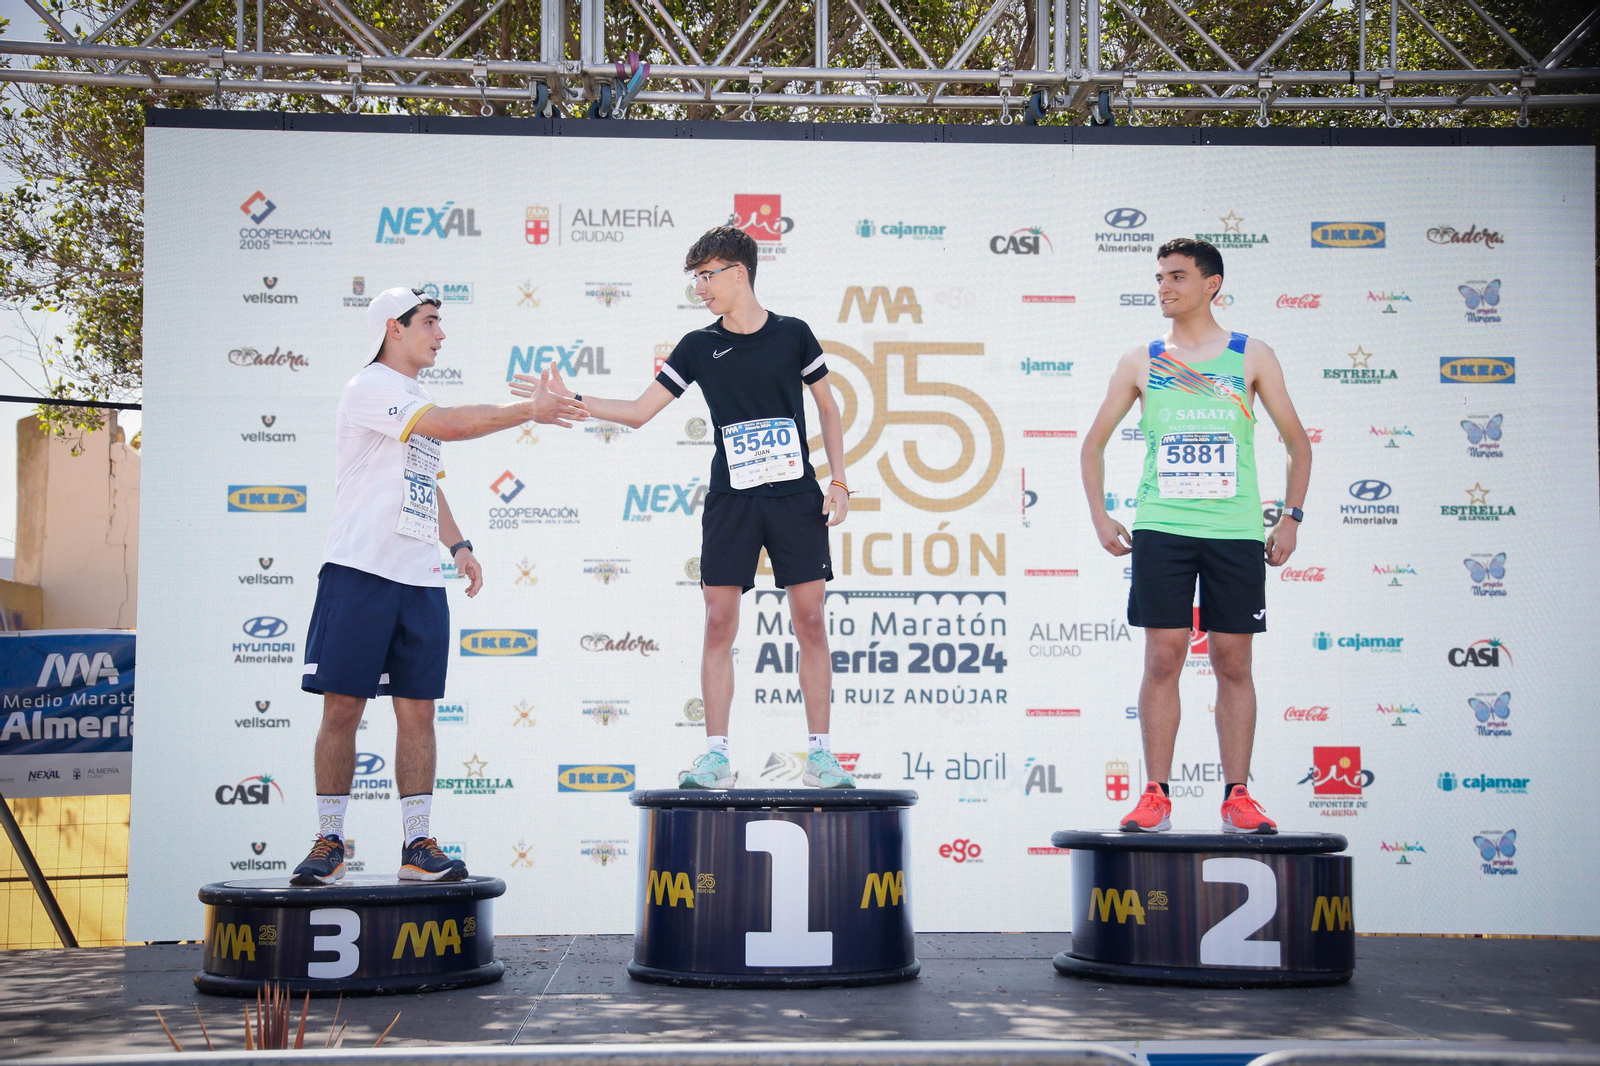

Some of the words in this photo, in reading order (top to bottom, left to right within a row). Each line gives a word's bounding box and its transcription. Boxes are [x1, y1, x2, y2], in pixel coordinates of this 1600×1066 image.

[376, 202, 482, 243] NEXAL
[571, 205, 674, 228] ALMERÍA
[240, 227, 331, 240] COOPERACIÓN
[571, 230, 624, 242] CIUDAD
[881, 221, 946, 239] cajamar
[1321, 229, 1377, 241] IKEA
[1095, 233, 1154, 242] HYUNDAI
[1195, 233, 1269, 243] ESTRELLA
[240, 240, 270, 250] 2005
[989, 235, 1040, 255] CASI
[1097, 244, 1153, 253] Almerialva
[443, 284, 469, 293] SAFA
[243, 292, 298, 304] vellsam
[1120, 294, 1156, 306] SER
[506, 340, 611, 382] NEXAL
[1021, 357, 1074, 377] jamar
[418, 367, 462, 379] RACIÓN
[1323, 369, 1398, 379] ESTRELLA
[1450, 364, 1506, 377] IKEA
[1176, 408, 1236, 420] SAKATA
[1169, 424, 1200, 432] PASSION
[1209, 423, 1226, 431] Seed
[241, 431, 296, 442] vellsam
[1121, 429, 1144, 440] SE
[733, 428, 791, 455] 5540
[754, 449, 770, 457] JUAN
[1166, 444, 1225, 464] 5881
[239, 493, 298, 505] IKEA
[623, 478, 709, 521] NEXA
[489, 506, 579, 518] COOPERACIÓN
[1340, 505, 1399, 514] HYUNDAI
[1440, 506, 1517, 516] ESTRELLA
[1262, 508, 1284, 527] SI
[1343, 516, 1398, 525] Almerialva
[489, 519, 519, 529] 2005
[238, 573, 294, 585] vellsam
[756, 611, 855, 636] Mio
[871, 611, 1006, 636] Maratón
[1030, 619, 1131, 642] ALMERÍA
[232, 643, 295, 652] HYUNDAI
[471, 637, 529, 648] IKEA
[1338, 633, 1404, 651] cajamar
[1029, 644, 1082, 657] CIUDAD
[235, 654, 293, 663] Almerialva
[755, 642, 899, 674] Alería
[908, 642, 1008, 674] 2024
[1448, 648, 1499, 667] CASI
[3, 694, 63, 709] Medio
[70, 690, 136, 706] Marató
[755, 688, 834, 704] RAM
[845, 688, 895, 704] RUIZ
[904, 685, 1008, 704] ANDÚJAR
[437, 705, 464, 713] SAFA
[0, 706, 134, 741] Almerí
[235, 717, 291, 728] vellsam
[87, 767, 120, 775] ALMERÍA
[902, 752, 935, 780] 14
[945, 752, 1005, 780] abril
[28, 768, 61, 781] NEXAL
[568, 772, 627, 784] IKEA
[351, 779, 392, 789] UNDAI
[436, 779, 514, 789] ESTRELLA
[1463, 773, 1530, 792] cajamar
[215, 785, 269, 805] CASI
[350, 791, 390, 800] erialva
[1166, 786, 1204, 797] UDAD
[320, 815, 343, 830] 25
[406, 815, 430, 831] 25
[440, 845, 461, 853] AFA
[939, 838, 981, 863] ego
[230, 859, 286, 871] vellsam
[697, 873, 716, 888] 25
[745, 820, 833, 967] 1
[1147, 890, 1168, 906] 25
[1200, 858, 1281, 967] 2
[462, 917, 476, 932] 25
[258, 924, 277, 940] 25
[307, 907, 361, 978] 3
